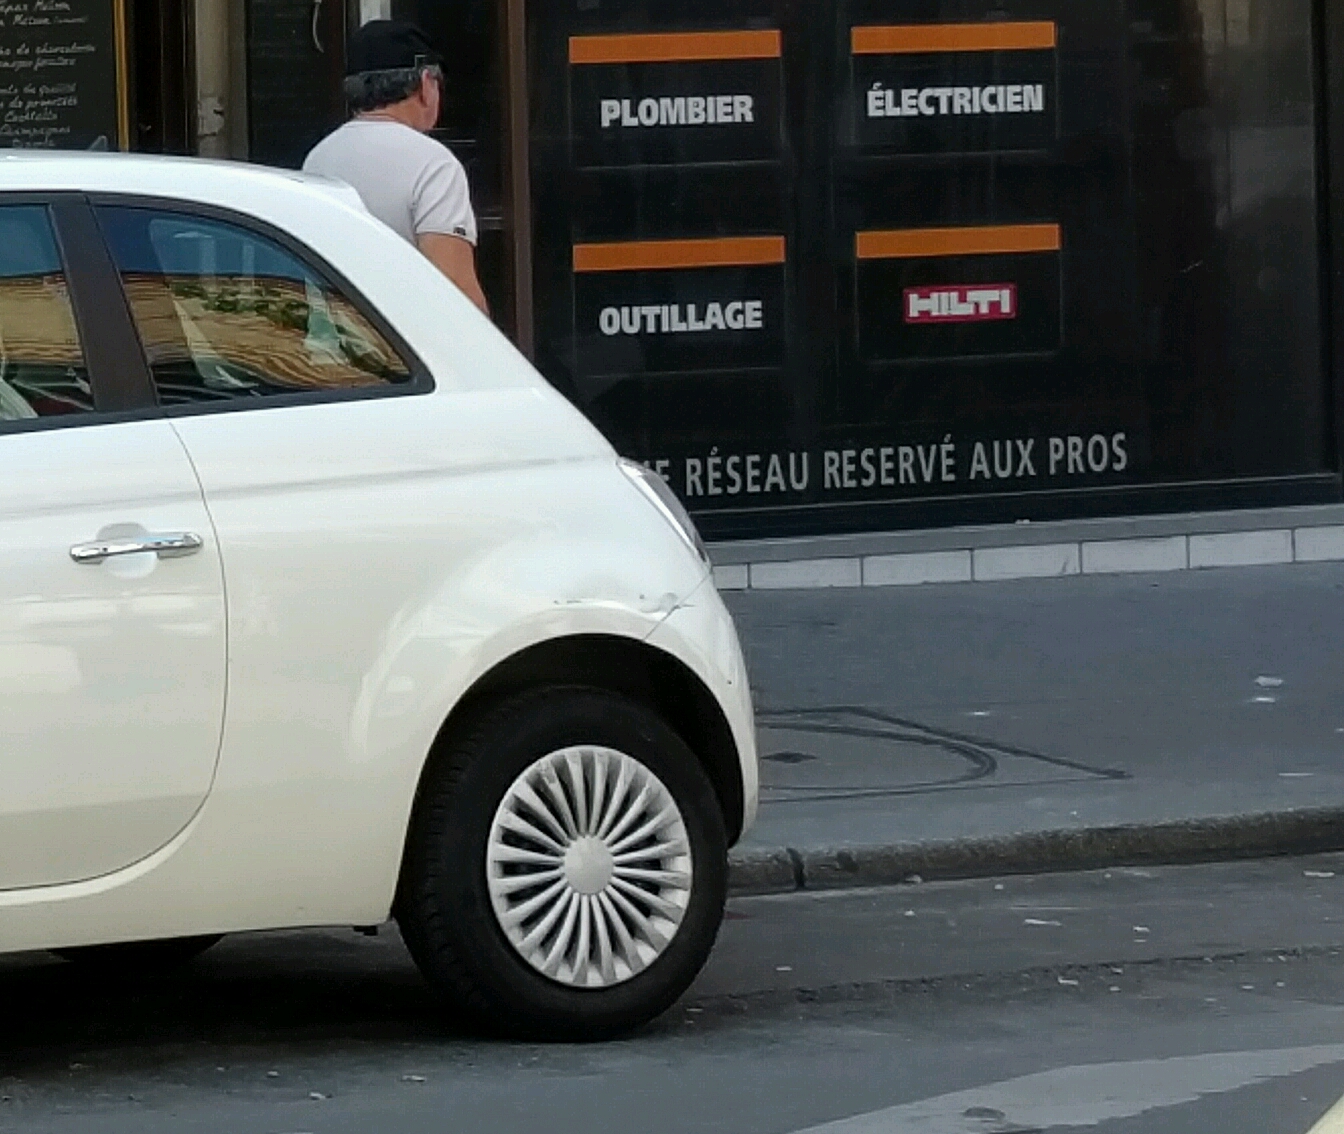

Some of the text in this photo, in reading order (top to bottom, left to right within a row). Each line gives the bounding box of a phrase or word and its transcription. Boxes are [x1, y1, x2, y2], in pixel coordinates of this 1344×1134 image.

[600, 94, 754, 128] PLOMBIER
[867, 81, 1044, 117] ÉLECTRICIEN
[599, 300, 763, 336] OUTILLAGE
[909, 289, 1011, 318] HILTI
[685, 446, 809, 497] RÉSEAU
[823, 433, 956, 490] RESERVÉ
[969, 438, 1037, 481] AUX
[1048, 432, 1127, 475] PROS
